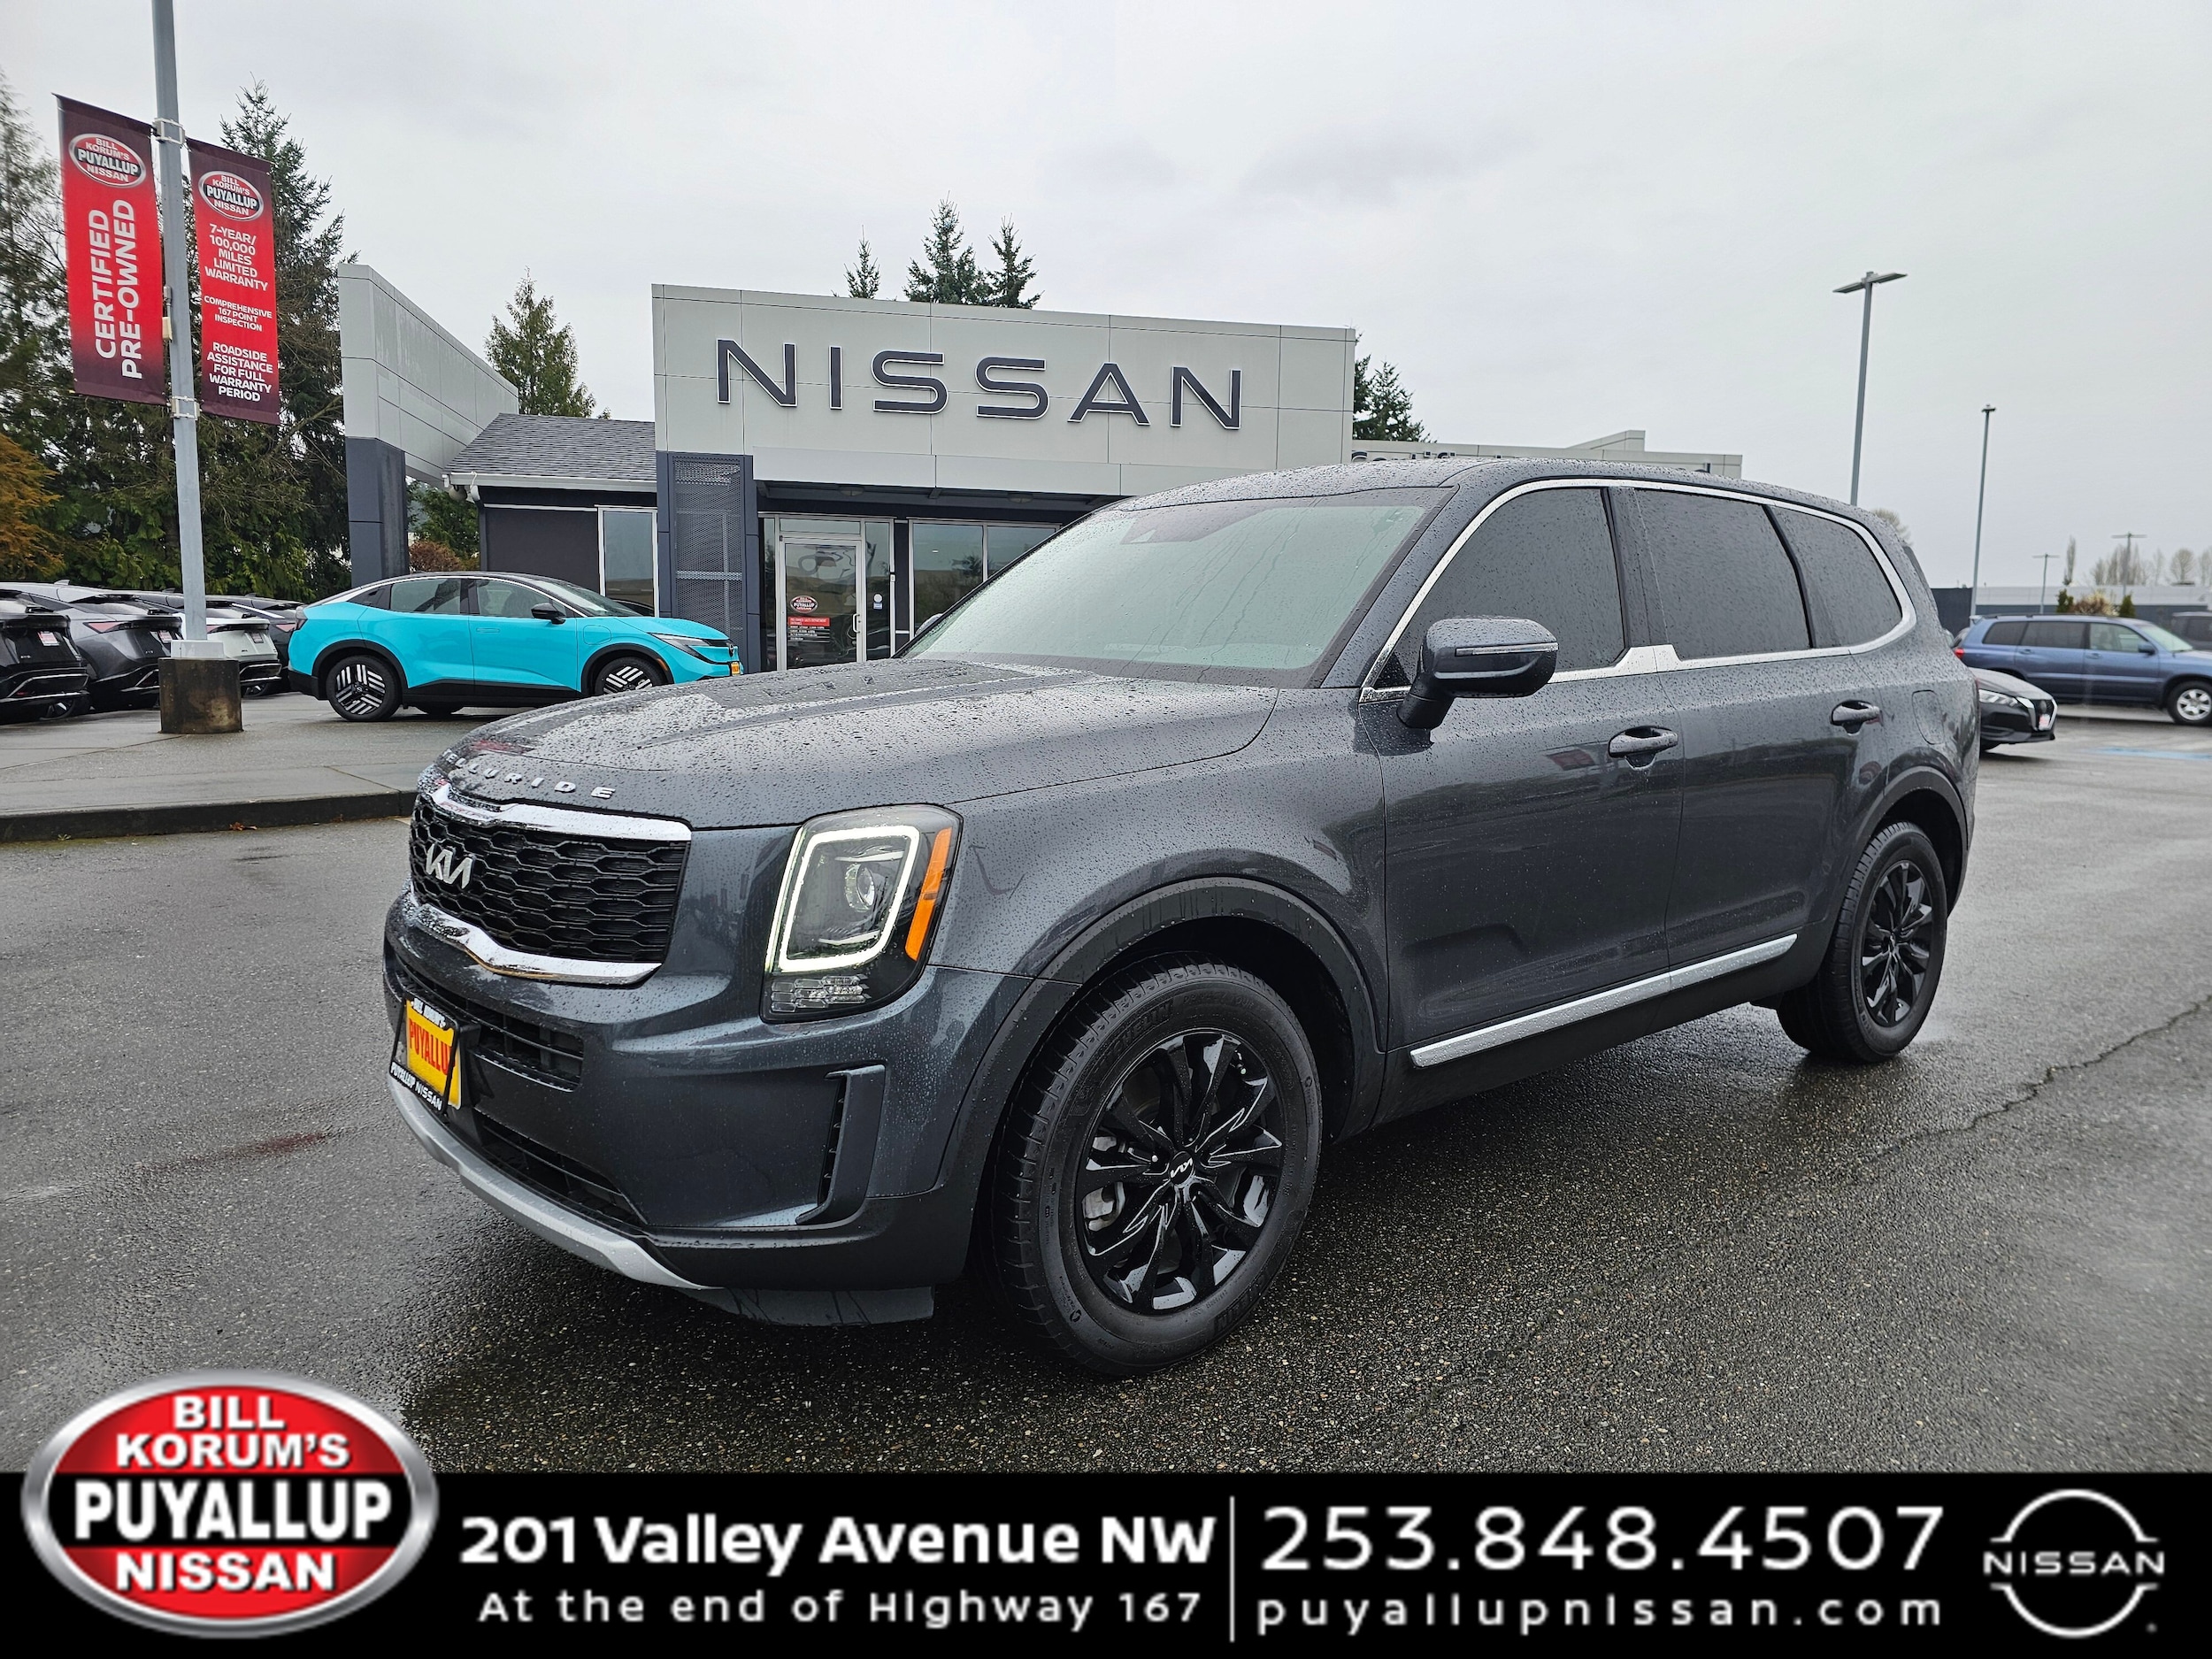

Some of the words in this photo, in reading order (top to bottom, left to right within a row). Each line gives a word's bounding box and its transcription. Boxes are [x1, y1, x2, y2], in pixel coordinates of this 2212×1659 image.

[85, 142, 129, 160] KORUM'S
[96, 137, 119, 150] BILL
[77, 149, 138, 175] PUYALLUP
[87, 165, 129, 182] NISSAN
[220, 175, 240, 186] BILL
[206, 185, 257, 209] PUYALLUP
[212, 179, 250, 196] KORUM'S
[213, 199, 250, 216] NISSAN
[209, 234, 256, 256] 100,000
[210, 223, 257, 245] 7-YEAR/
[213, 257, 258, 278] LIMITED
[219, 248, 252, 265] MILES
[88, 209, 116, 359] CERTIFIED
[113, 199, 142, 379] PRE-OWNED
[204, 265, 268, 291] WARRANTY
[204, 296, 273, 319] COMPREHENSIVE
[218, 307, 231, 316] 167
[232, 311, 257, 323] POINT
[214, 313, 263, 332] INSPECTION
[206, 351, 273, 373] ASSISTANCE
[212, 342, 267, 363] ROADSIDE
[209, 373, 272, 394] WARRANTY
[213, 363, 236, 377] FOR
[237, 368, 265, 382] FULL
[219, 385, 261, 402] PERIOD
[716, 337, 1241, 431] NISSAN
[443, 749, 616, 800] TELLURIDE
[425, 842, 473, 889] KIA
[409, 1018, 456, 1077] PUYALLU
[390, 1061, 416, 1089] PUYALLUP
[415, 1081, 443, 1111] NISSAN
